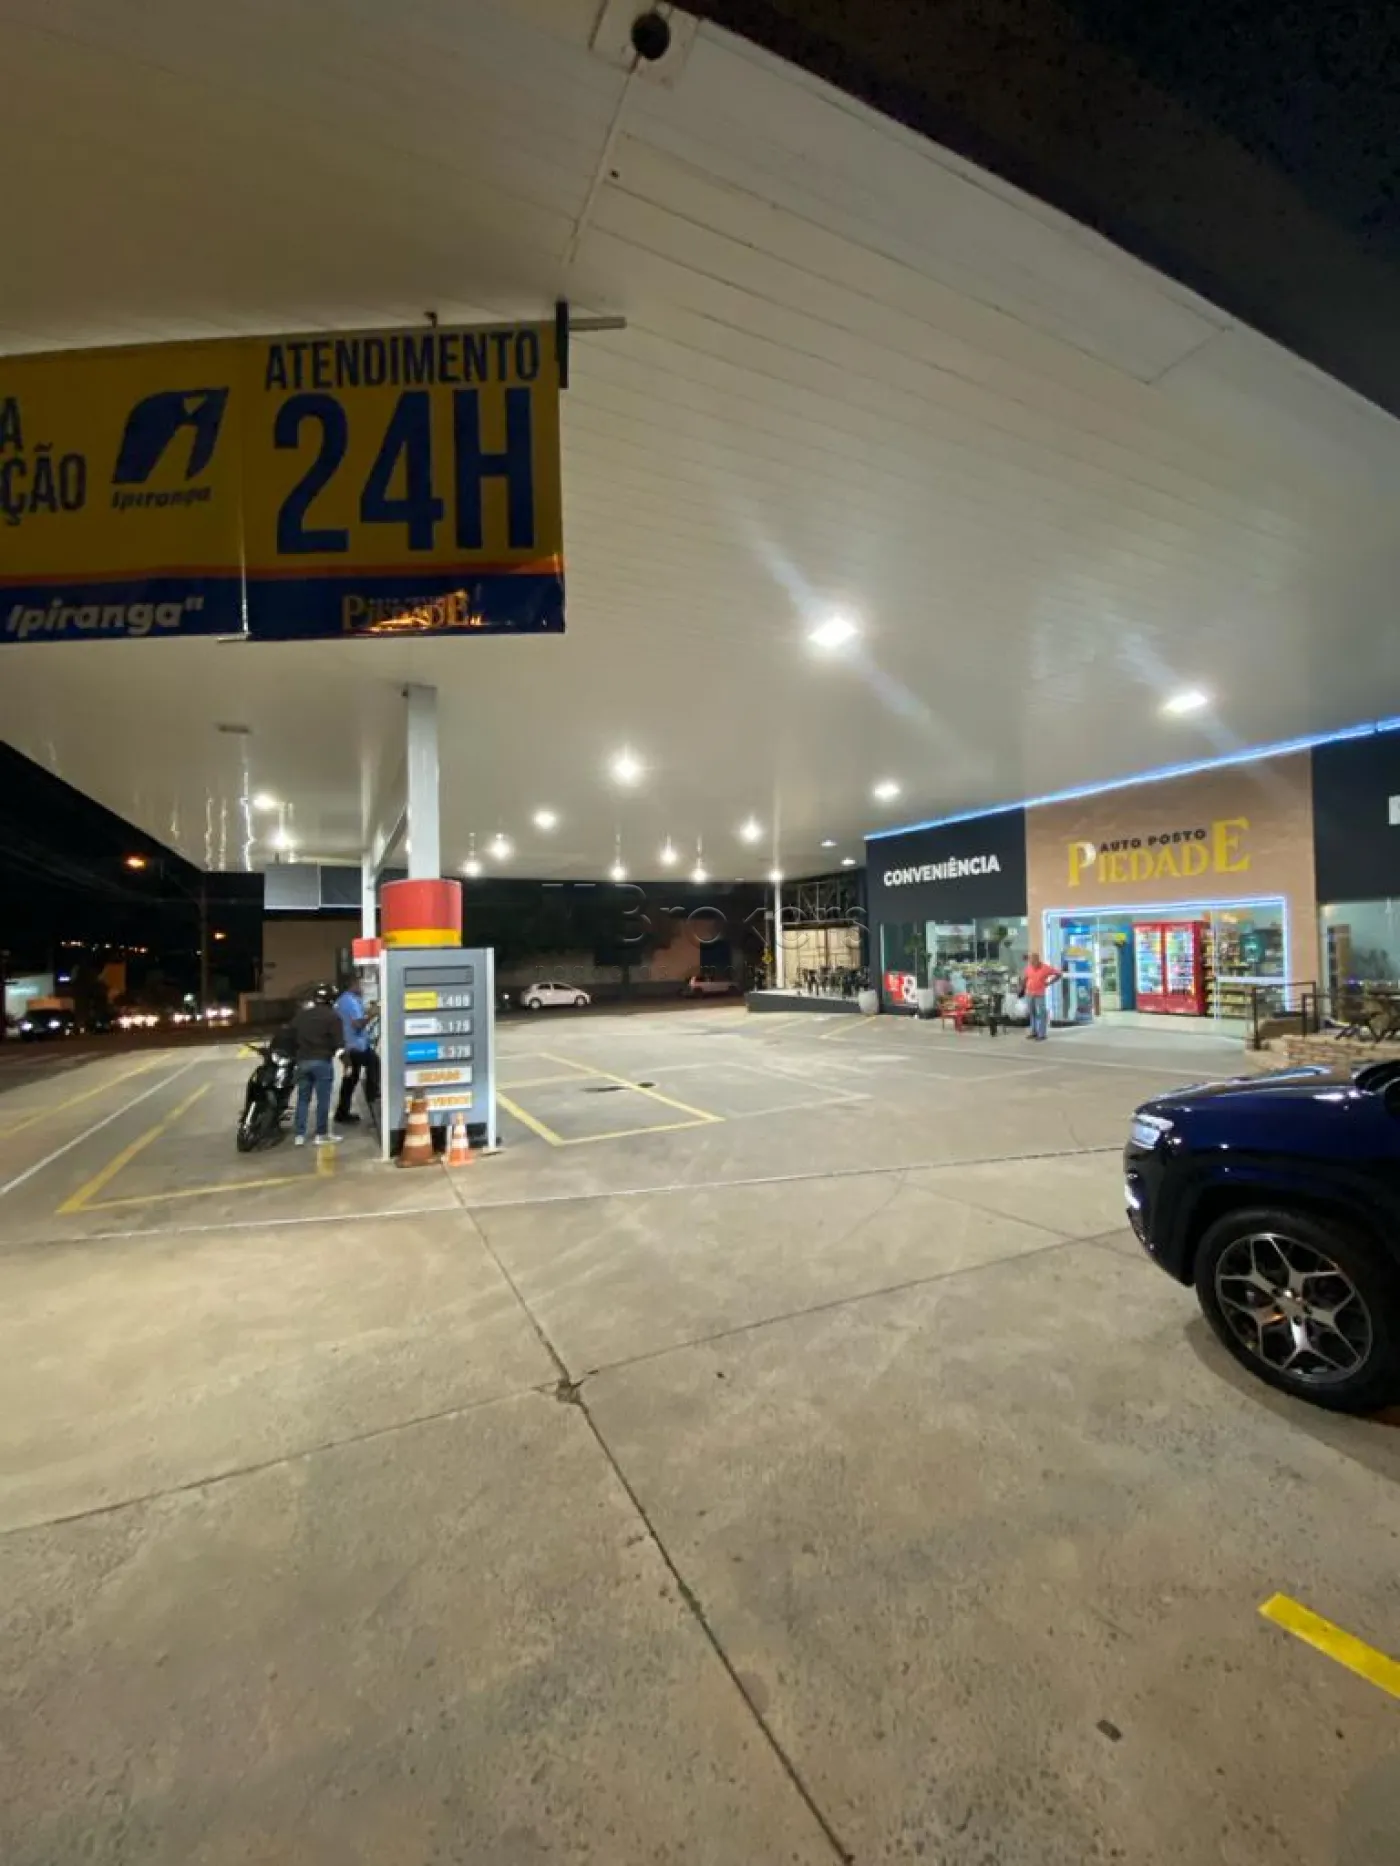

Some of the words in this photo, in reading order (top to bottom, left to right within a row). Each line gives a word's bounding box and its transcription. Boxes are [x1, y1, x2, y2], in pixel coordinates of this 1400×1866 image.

[264, 329, 540, 391] ATENDIMENTO
[273, 386, 535, 555] 24H
[112, 487, 212, 511] Ipiranga
[1067, 816, 1251, 888] PIEDADE
[1100, 838, 1142, 853] AUTO
[1148, 829, 1207, 846] POSTO
[883, 854, 1002, 886] CONVENIÊNCIA
